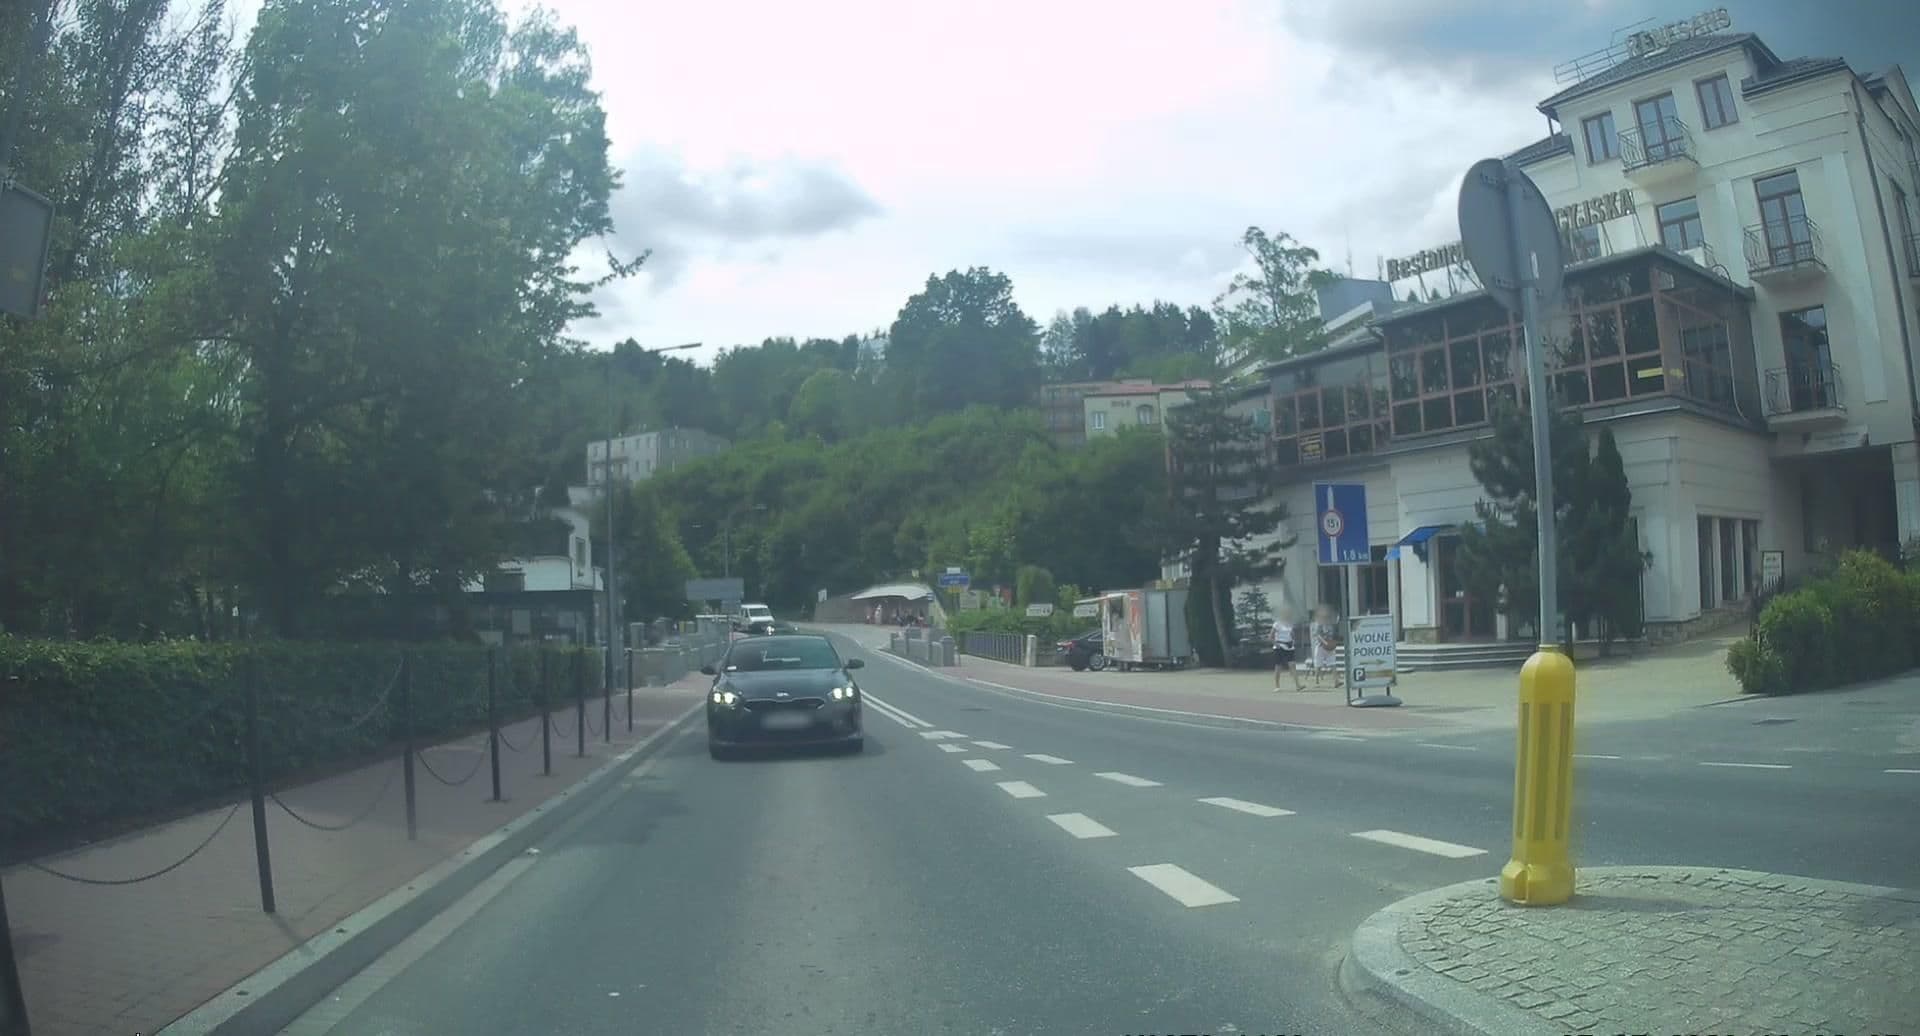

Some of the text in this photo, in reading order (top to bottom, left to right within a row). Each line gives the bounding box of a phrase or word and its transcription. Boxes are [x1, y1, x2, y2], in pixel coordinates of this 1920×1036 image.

[1555, 189, 1635, 229] CYJSKA
[1354, 632, 1391, 643] WOLNE
[1353, 646, 1392, 657] POKOJE
